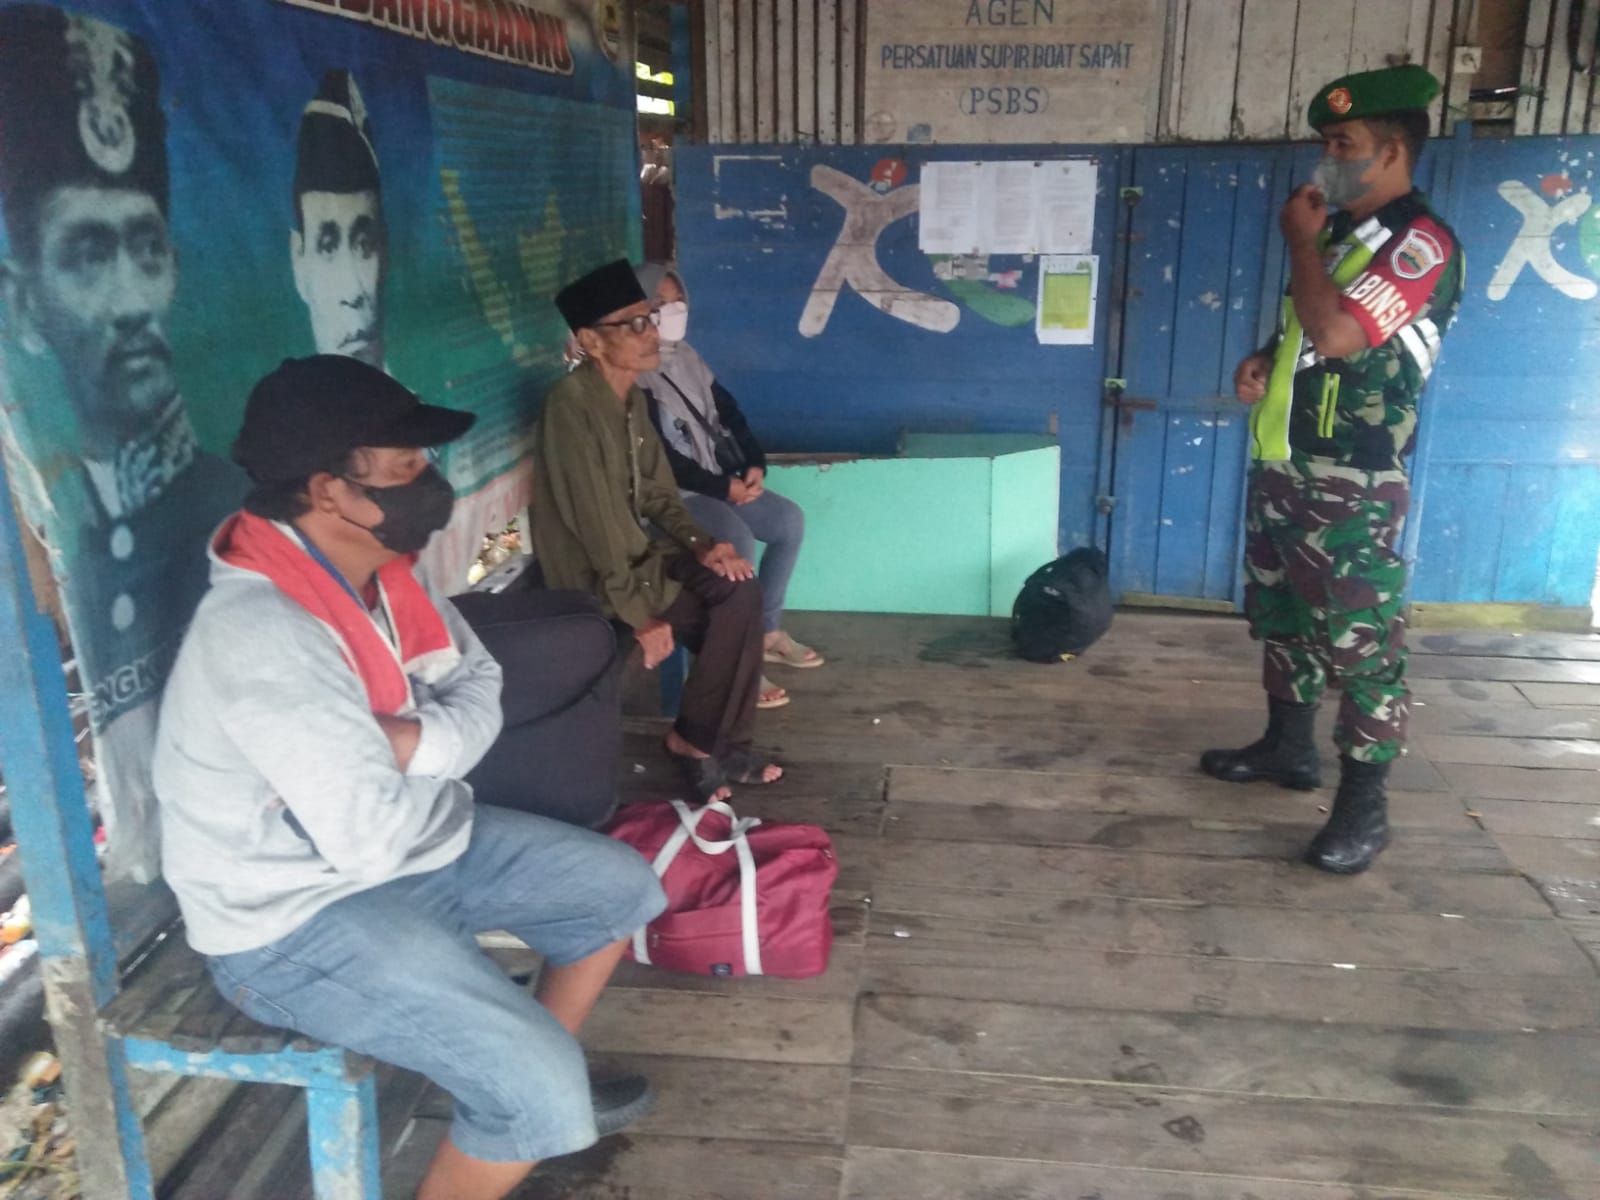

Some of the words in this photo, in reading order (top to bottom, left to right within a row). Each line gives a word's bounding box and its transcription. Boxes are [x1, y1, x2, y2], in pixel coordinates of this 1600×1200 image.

[965, 0, 1054, 26] AGEN
[881, 44, 977, 69] PERSATUAN
[980, 44, 1030, 69] SUPIR
[1032, 43, 1076, 69] BOAT
[1079, 42, 1135, 69] SAPAT
